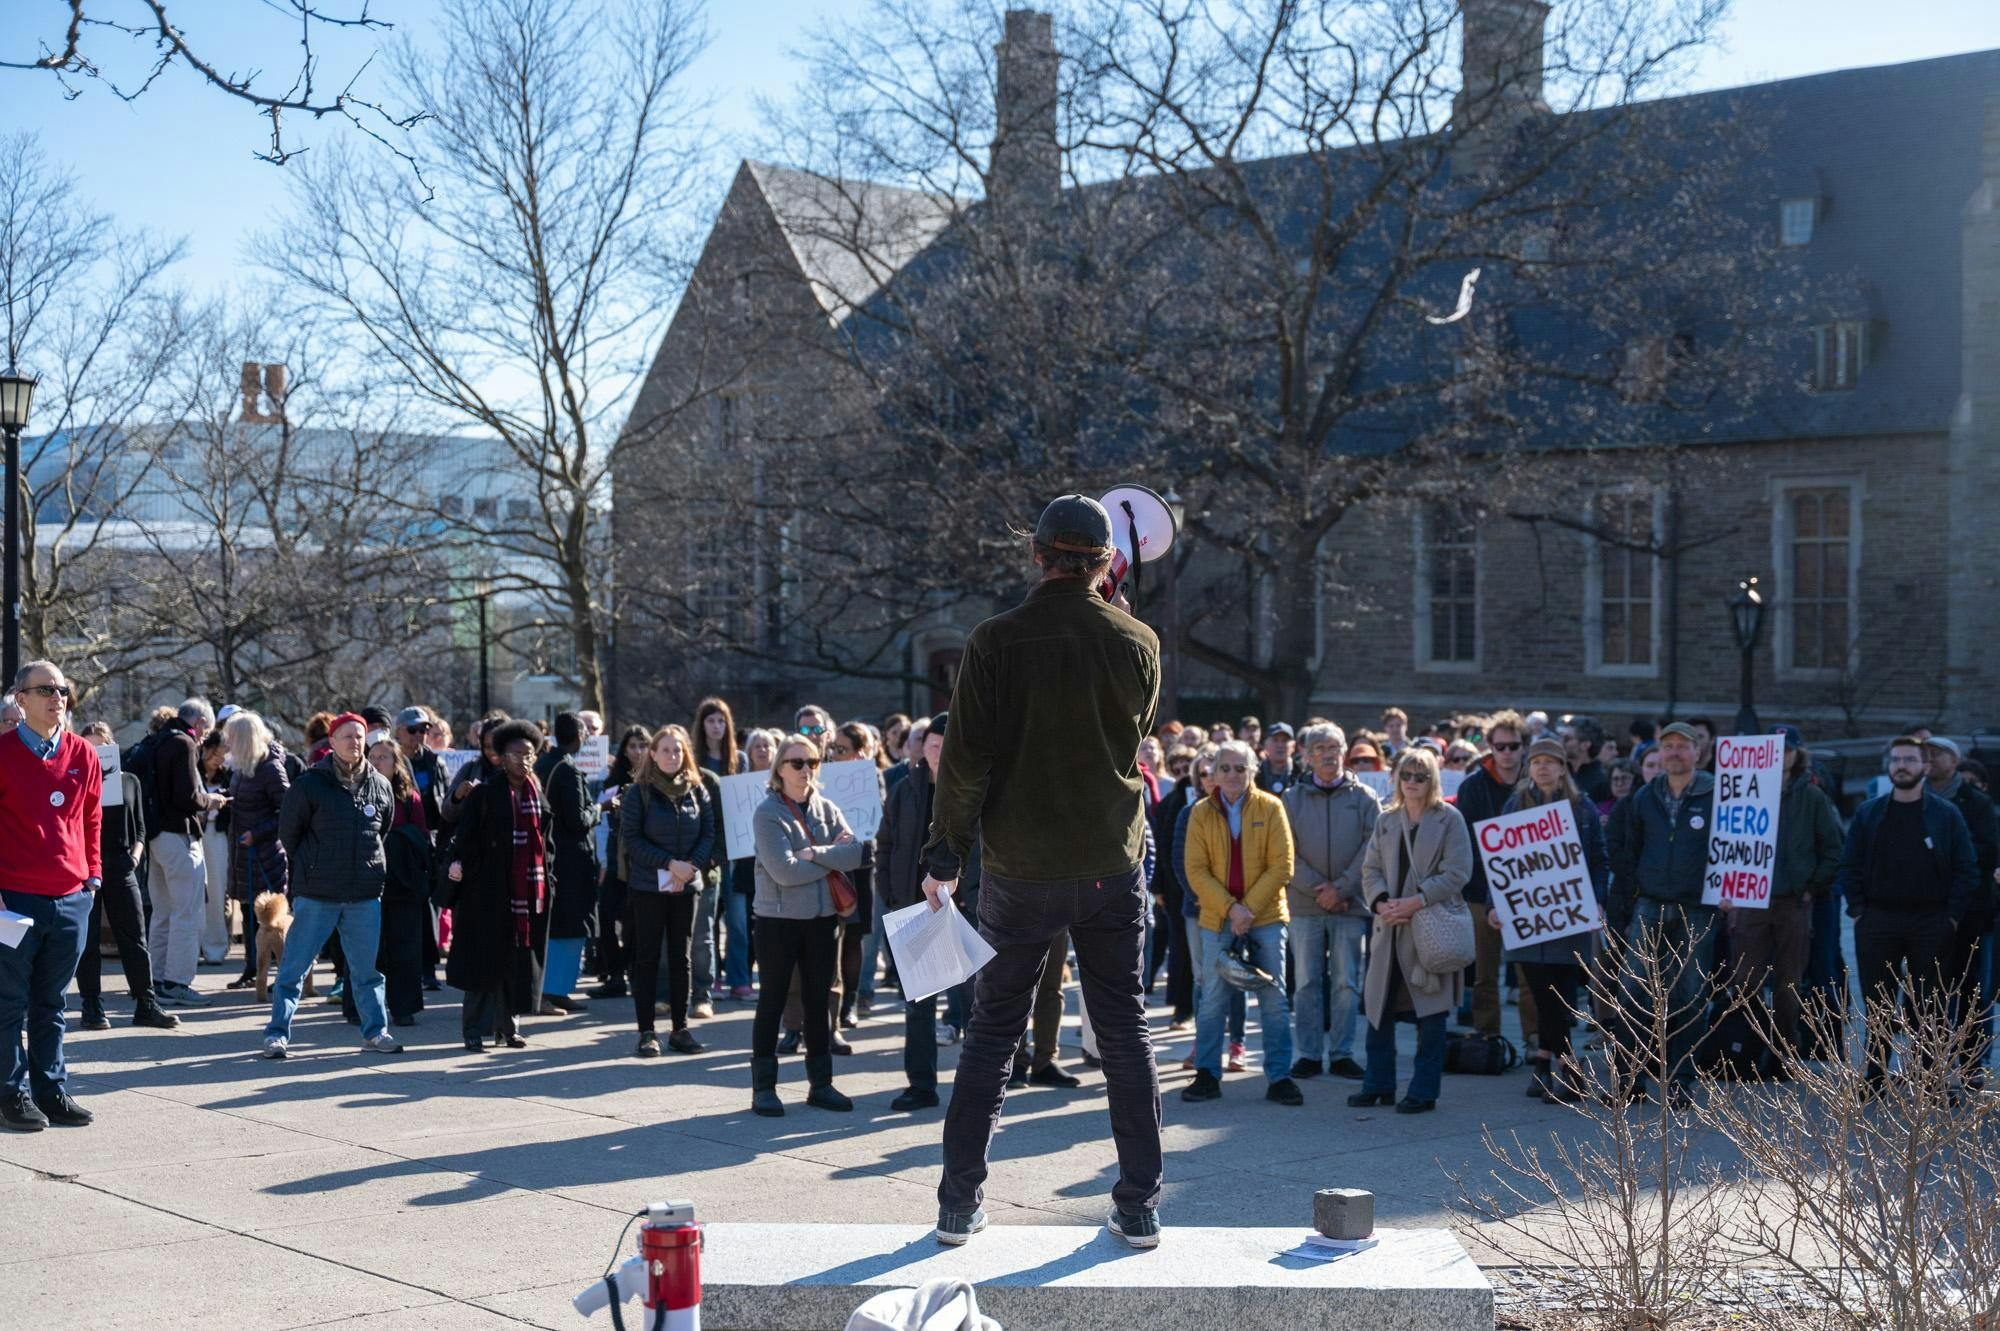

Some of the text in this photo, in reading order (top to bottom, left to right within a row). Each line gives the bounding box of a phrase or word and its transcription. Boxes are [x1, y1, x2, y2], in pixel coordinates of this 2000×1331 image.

[1718, 739, 1780, 769] Cornell:
[1720, 773, 1760, 802] BE A
[1480, 809, 1570, 853] Cornell:
[1716, 805, 1769, 836] HERO
[1504, 877, 1583, 915] FIGHT
[1706, 870, 1768, 901] TO NERO
[1512, 904, 1590, 941] BACK
